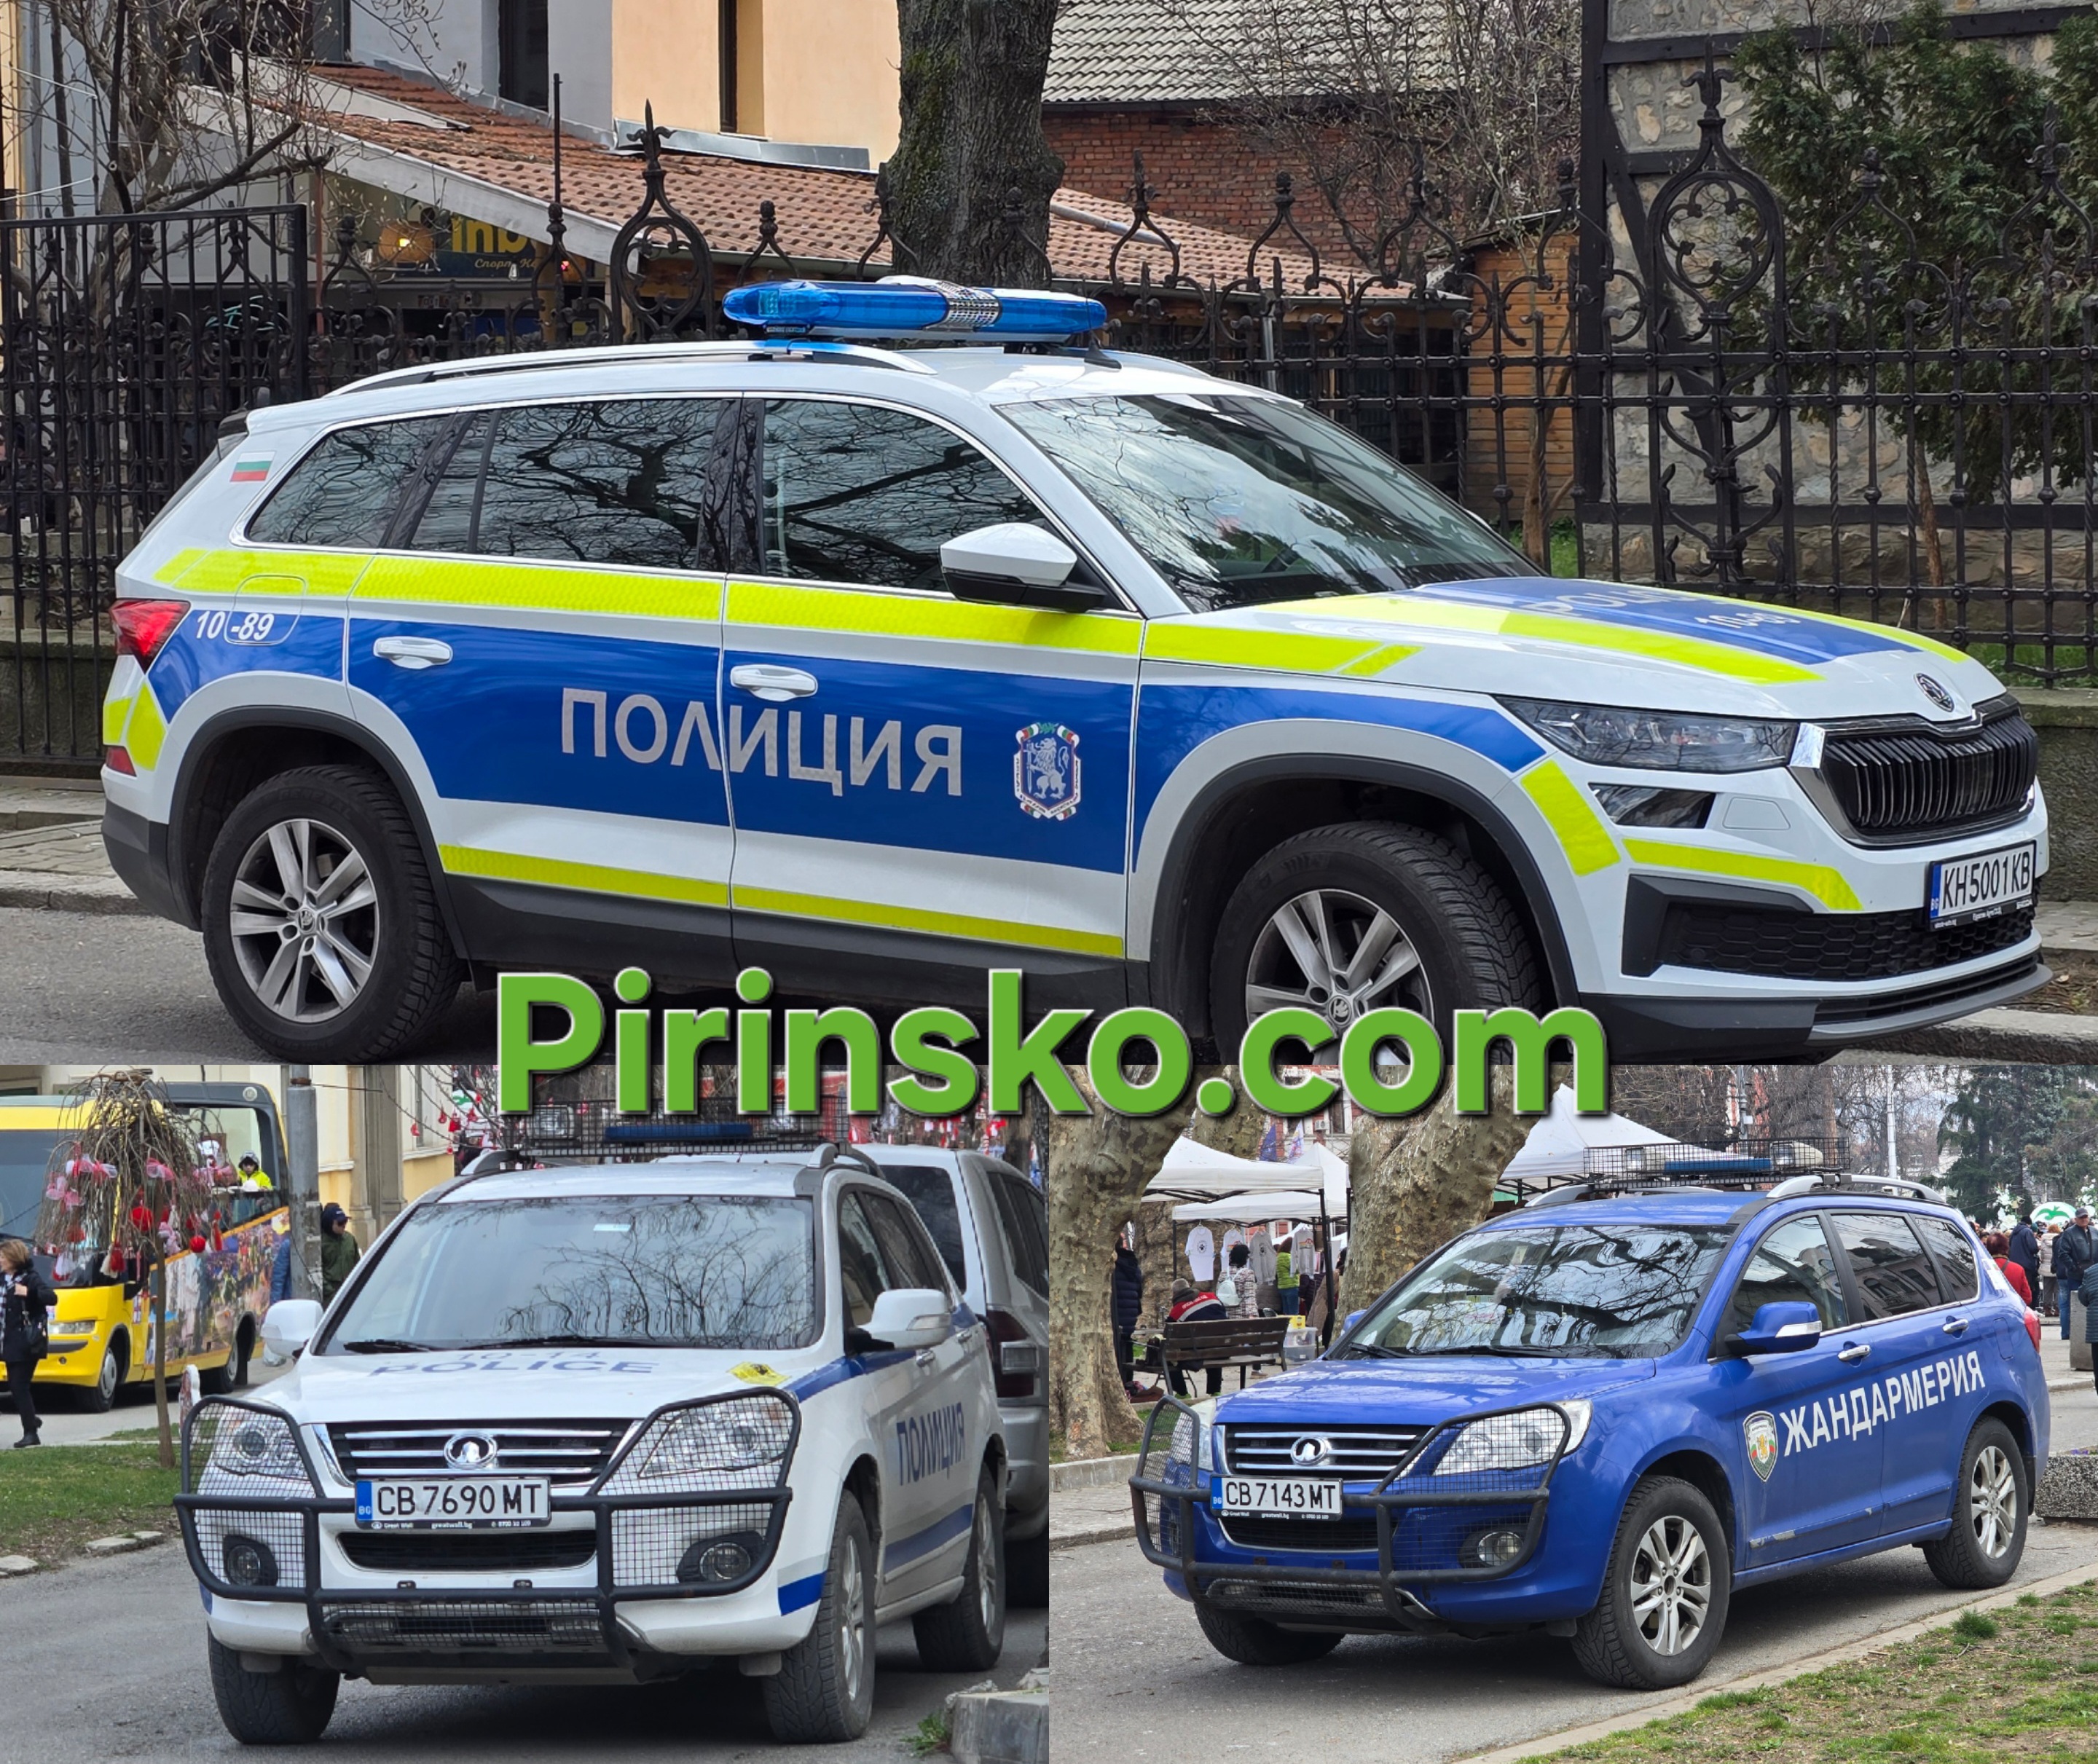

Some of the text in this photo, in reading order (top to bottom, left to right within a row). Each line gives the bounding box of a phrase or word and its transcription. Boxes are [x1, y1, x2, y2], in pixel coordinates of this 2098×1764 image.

[196, 610, 275, 641] 10-89
[561, 687, 962, 796] ПОЛИЦИЯ
[367, 1361, 659, 1377] POLICE
[1779, 1350, 1986, 1457] ЖАНДАРМЕРИЯ
[896, 1401, 965, 1487] ПОЛИЦИЯ
[358, 1505, 372, 1515] BG
